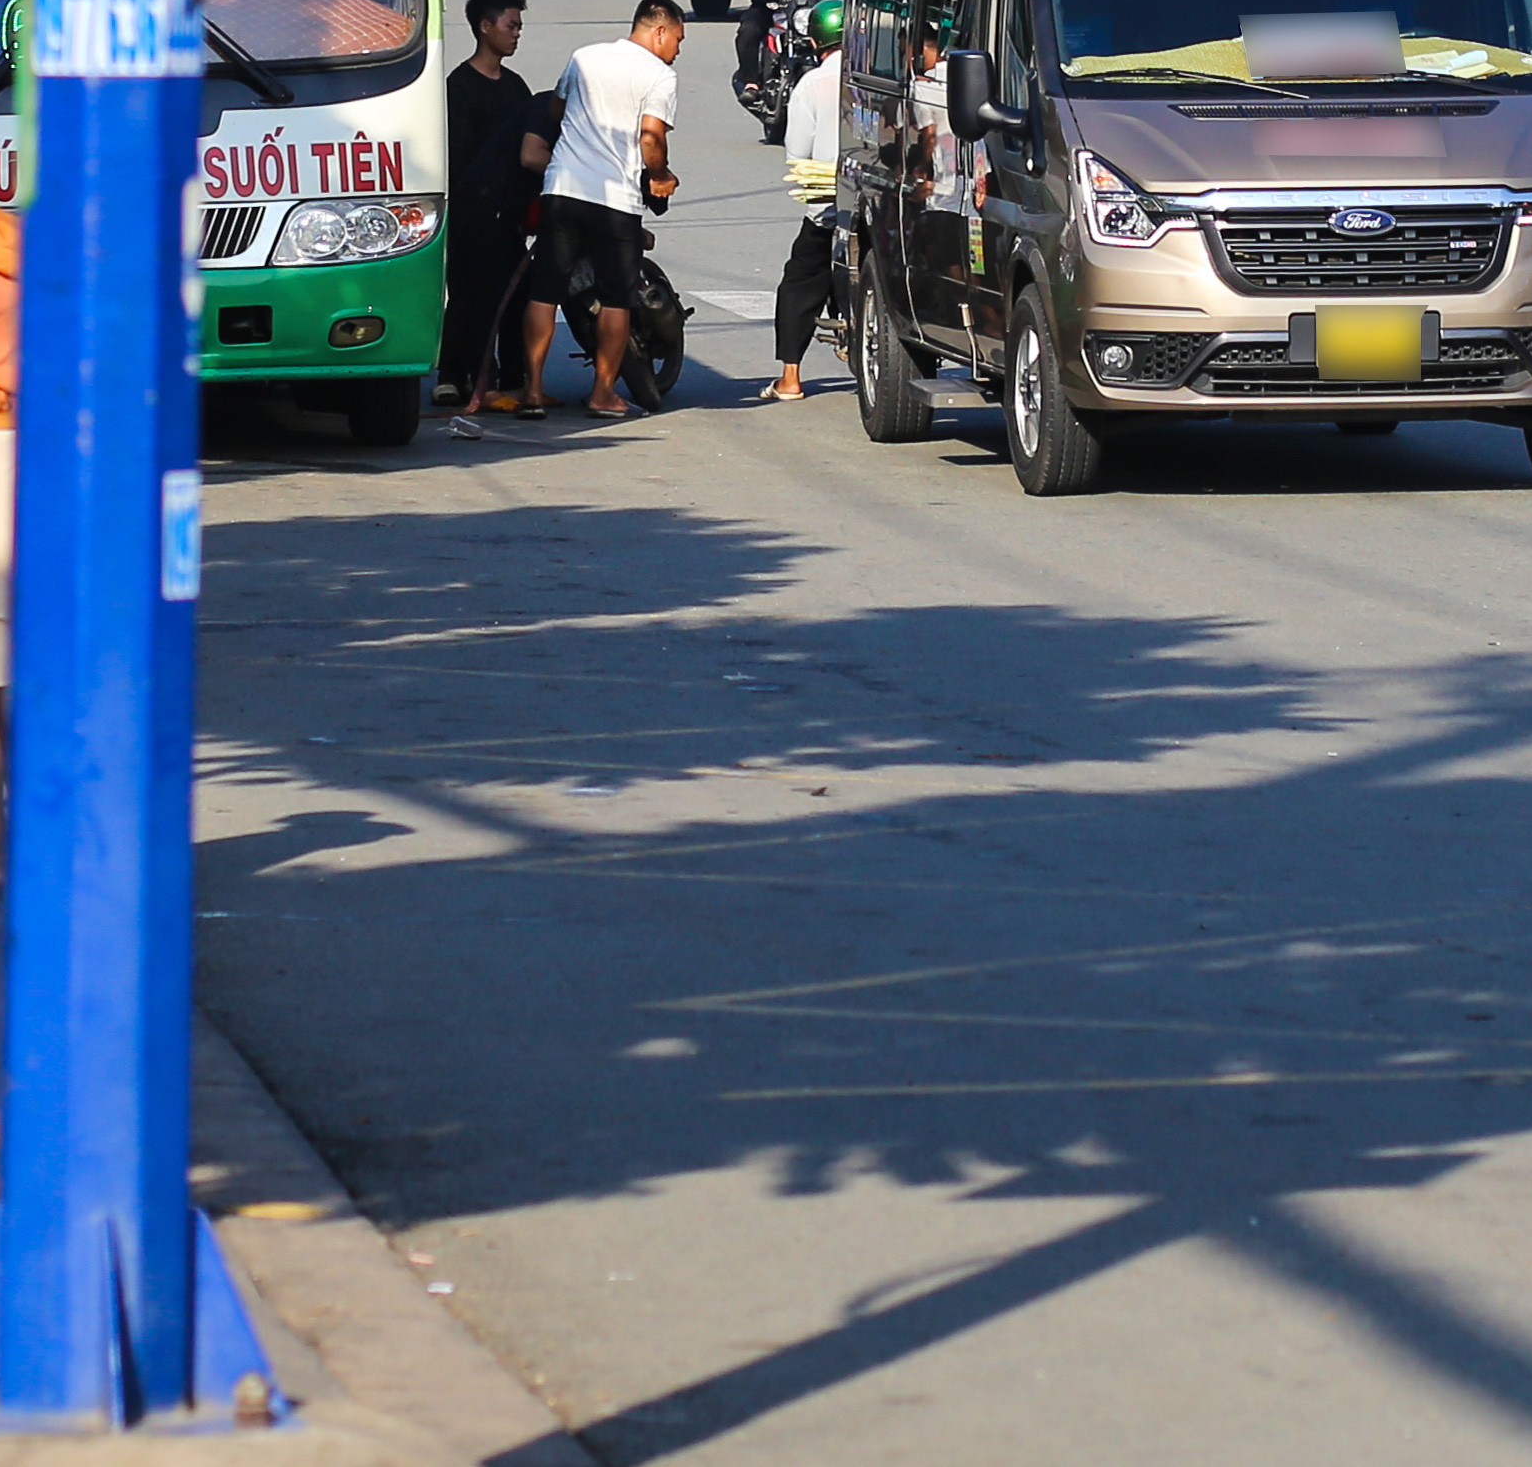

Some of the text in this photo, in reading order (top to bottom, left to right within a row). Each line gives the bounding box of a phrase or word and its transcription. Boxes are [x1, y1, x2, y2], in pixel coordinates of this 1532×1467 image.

[202, 125, 404, 200] SUỐI TIÊN
[1229, 190, 1489, 204] TRANSIT
[1343, 212, 1382, 230] Ford
